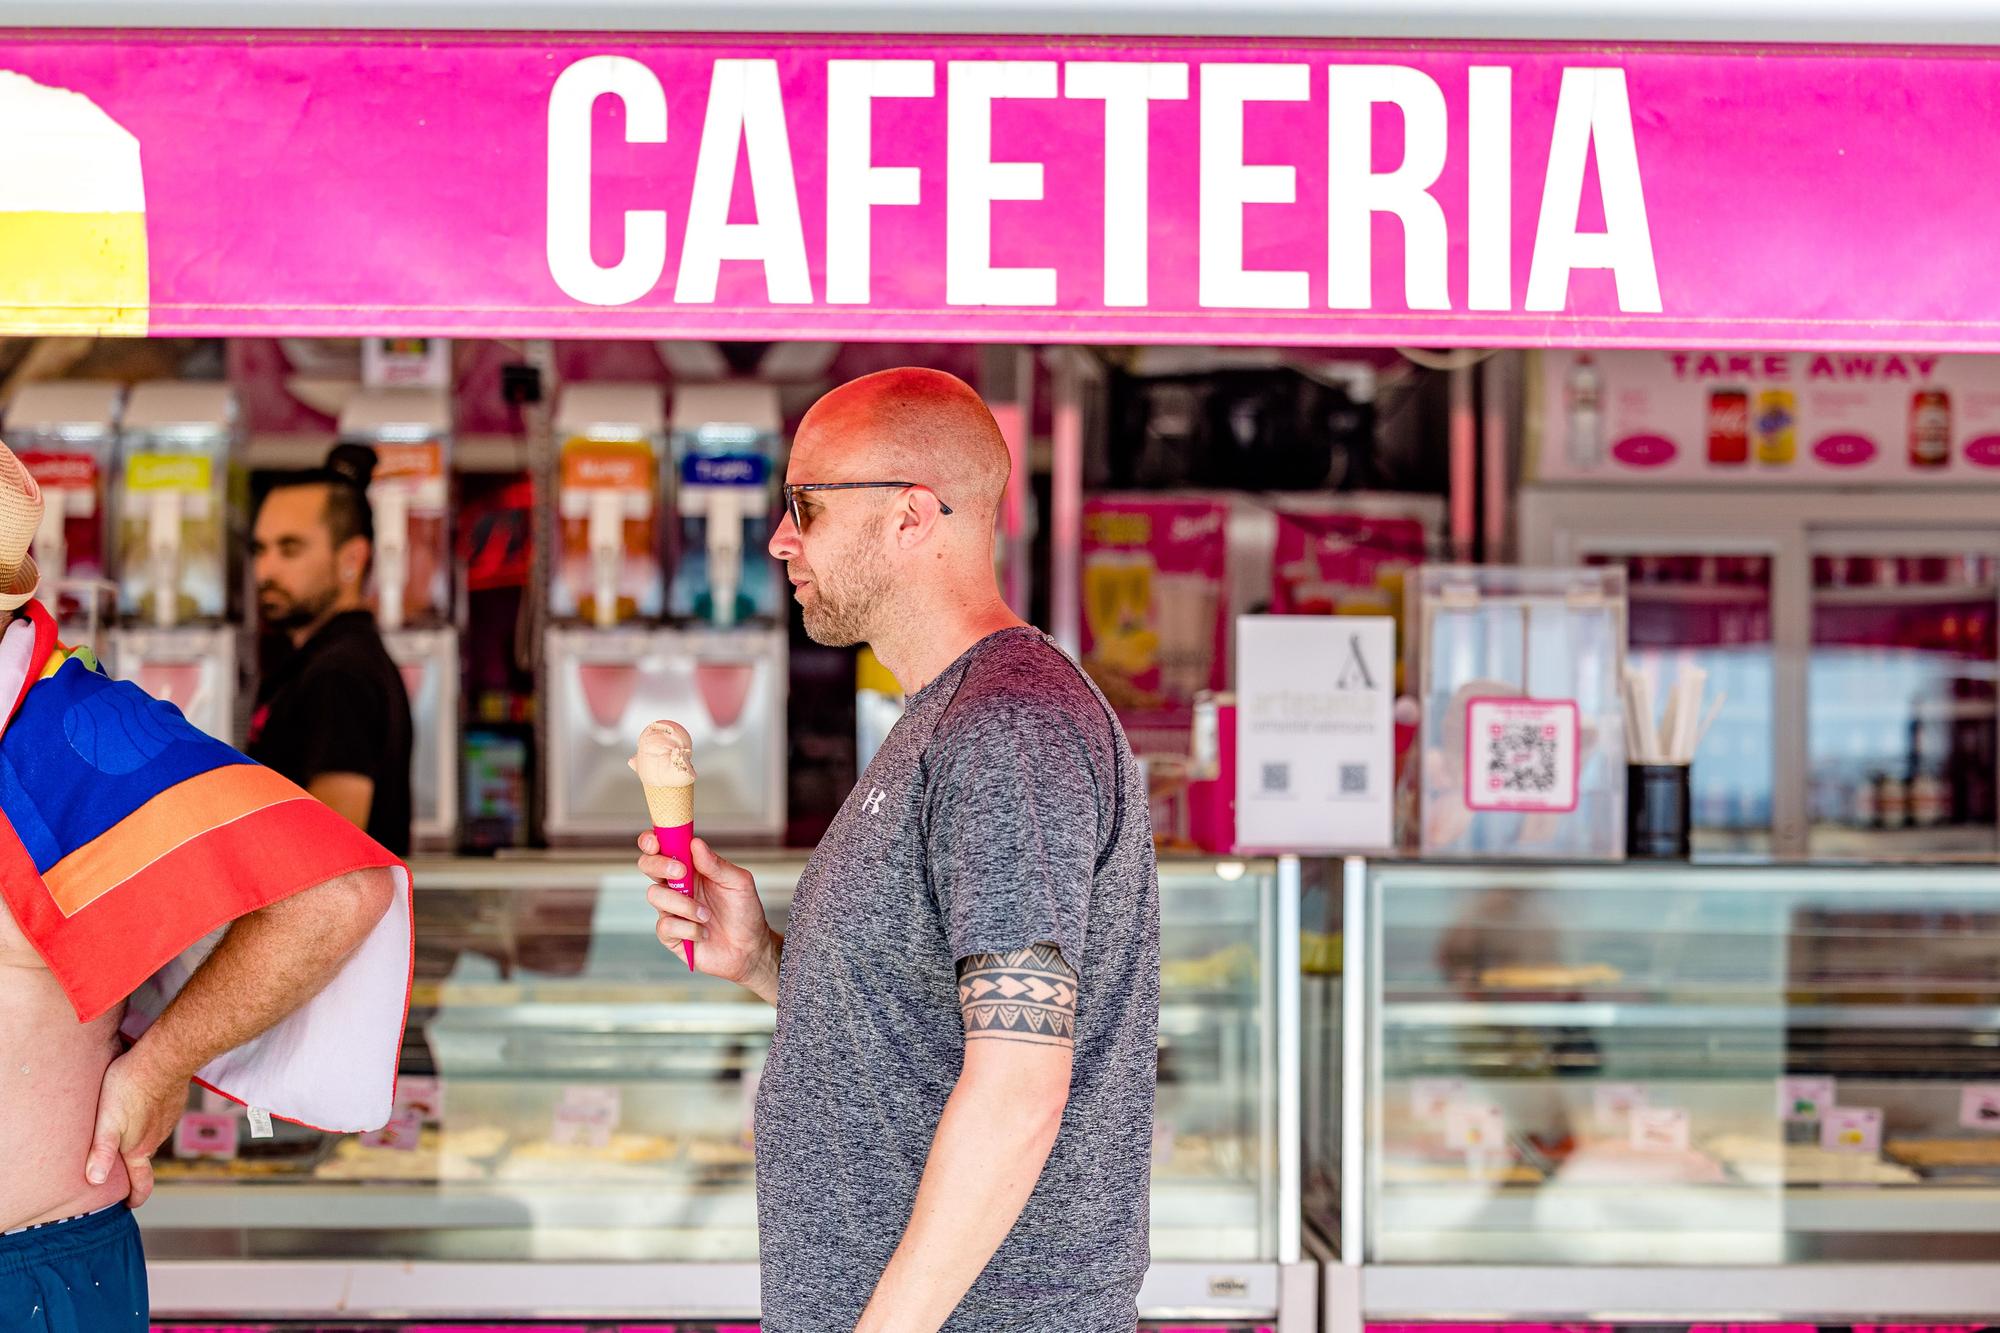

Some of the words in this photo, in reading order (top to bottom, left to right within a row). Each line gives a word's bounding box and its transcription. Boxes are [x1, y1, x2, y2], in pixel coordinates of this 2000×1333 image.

[545, 55, 1663, 314] CAFETERIA
[1669, 354, 1790, 380] TAKE
[1807, 354, 1939, 381] AWAY
